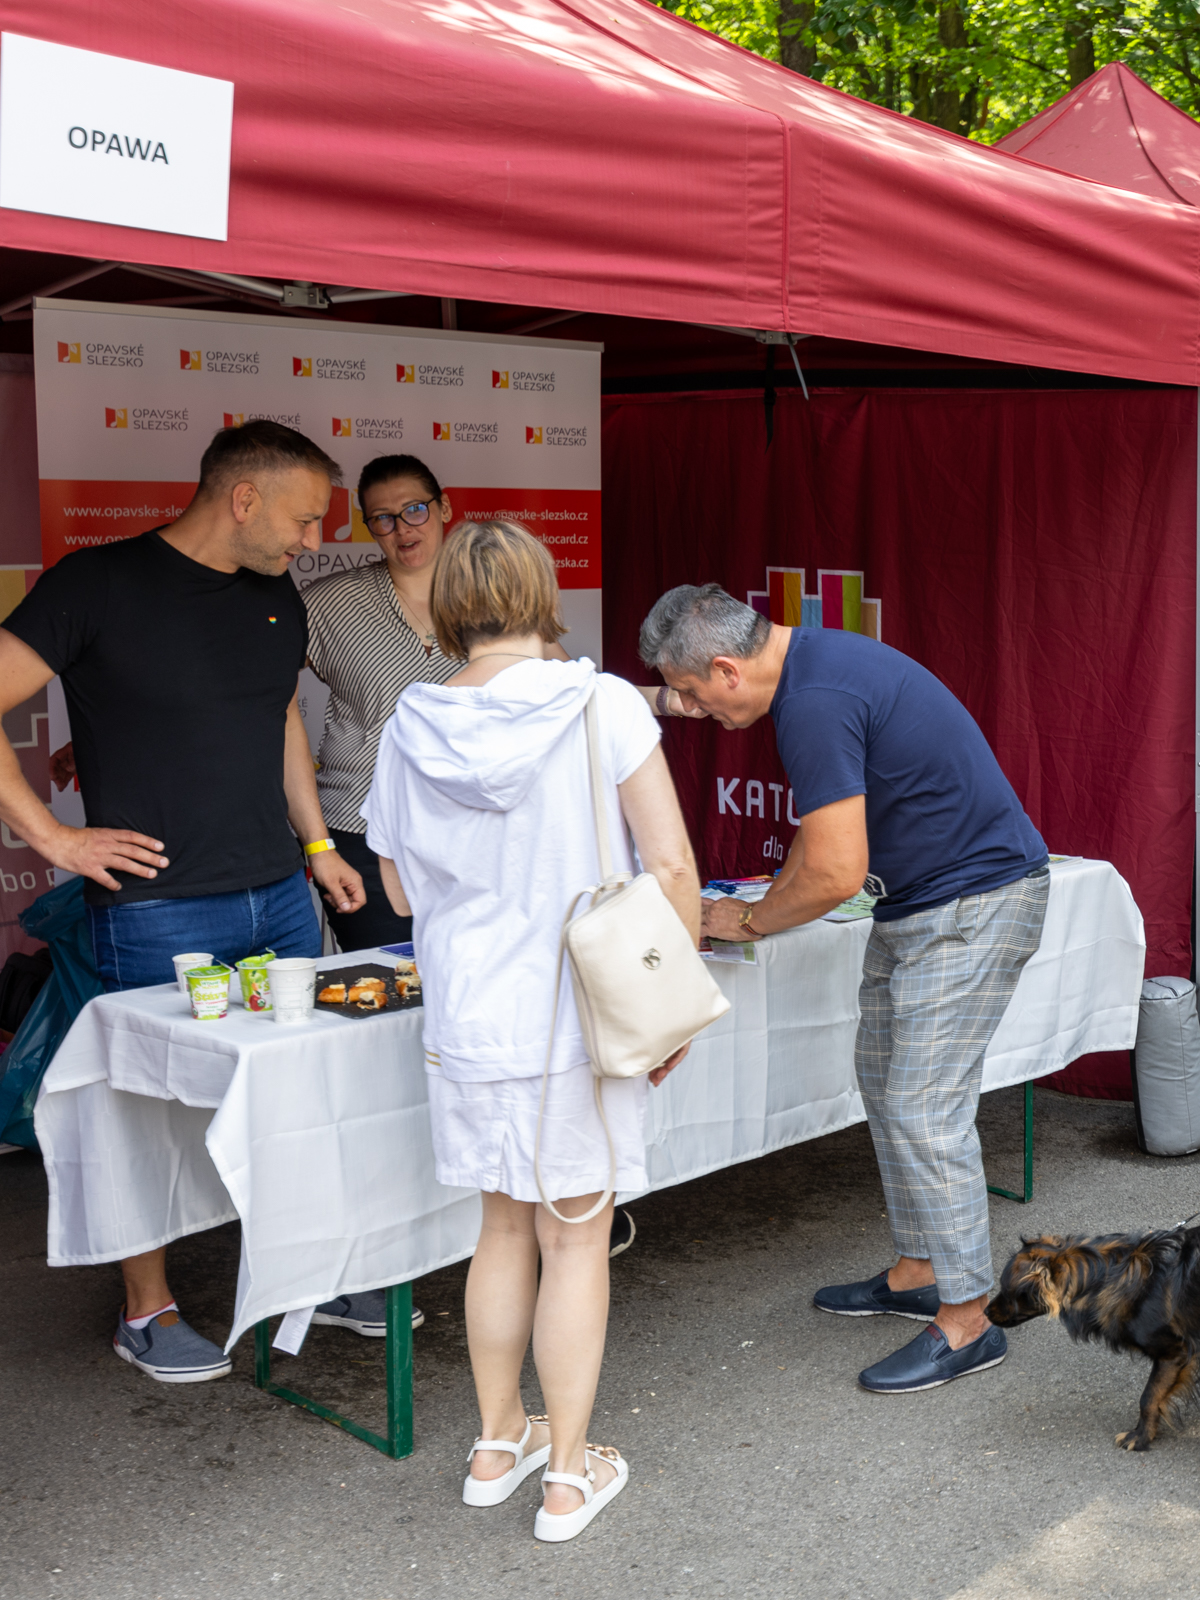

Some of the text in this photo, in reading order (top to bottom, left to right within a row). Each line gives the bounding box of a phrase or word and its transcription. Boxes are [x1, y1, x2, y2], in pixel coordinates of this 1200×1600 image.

[69, 126, 169, 164] OPAWA
[86, 343, 144, 356] OPAVSKÉ
[87, 355, 143, 367] SLEZSKO
[206, 351, 260, 363] OPAVSKÉ
[207, 363, 259, 374] SLEZSKO
[316, 358, 366, 370] OPAVSKÉ
[317, 369, 365, 380] SLEZSKO
[418, 365, 464, 376] OPAVSKÉ
[419, 376, 464, 386] SLEZSKO
[513, 371, 555, 382] OPAVSKÉ
[513, 382, 554, 392] SLEZSKO
[133, 408, 188, 420] OPAVSKÉ
[133, 420, 188, 431] SLEZSKO
[356, 418, 404, 429] OPAVSKÉ
[454, 422, 498, 433] OPAVSKÉ
[356, 429, 403, 439] SLEZSKO
[546, 426, 587, 437] OPAVSKÉ
[454, 432, 498, 443] SLEZSKO
[547, 437, 586, 446] SLEZSKO
[64, 505, 185, 519] www.opavske-sle
[464, 509, 588, 521] www.opavske-slezsko.cz
[763, 836, 783, 861] dla
